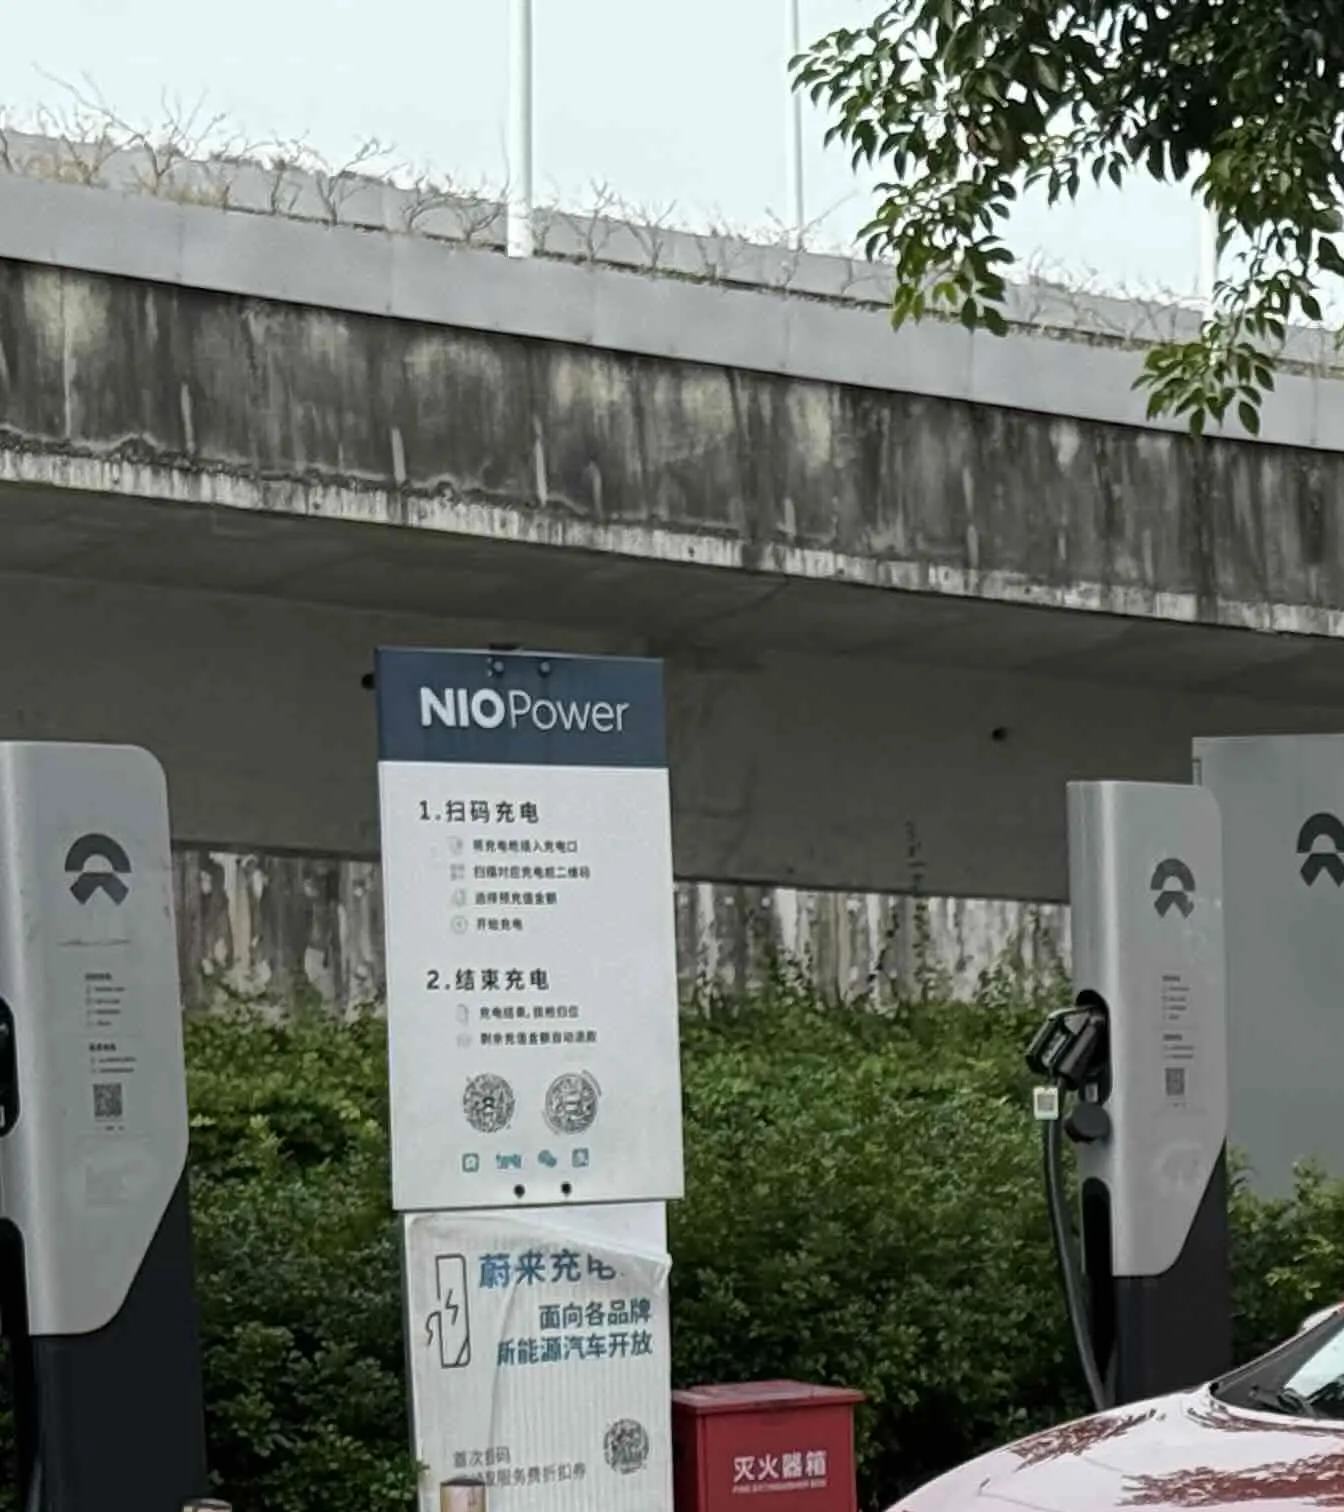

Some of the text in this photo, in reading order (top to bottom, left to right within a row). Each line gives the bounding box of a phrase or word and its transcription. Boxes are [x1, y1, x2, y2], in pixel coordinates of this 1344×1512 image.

[419, 687, 630, 732] NIOPower
[419, 800, 539, 824] 1.扫码充电
[426, 968, 550, 992] 2.结束充电
[538, 1298, 652, 1330] 面向各品牌
[496, 1329, 654, 1367] 新能源汽车开放
[733, 1450, 828, 1483] 灭火器箱
